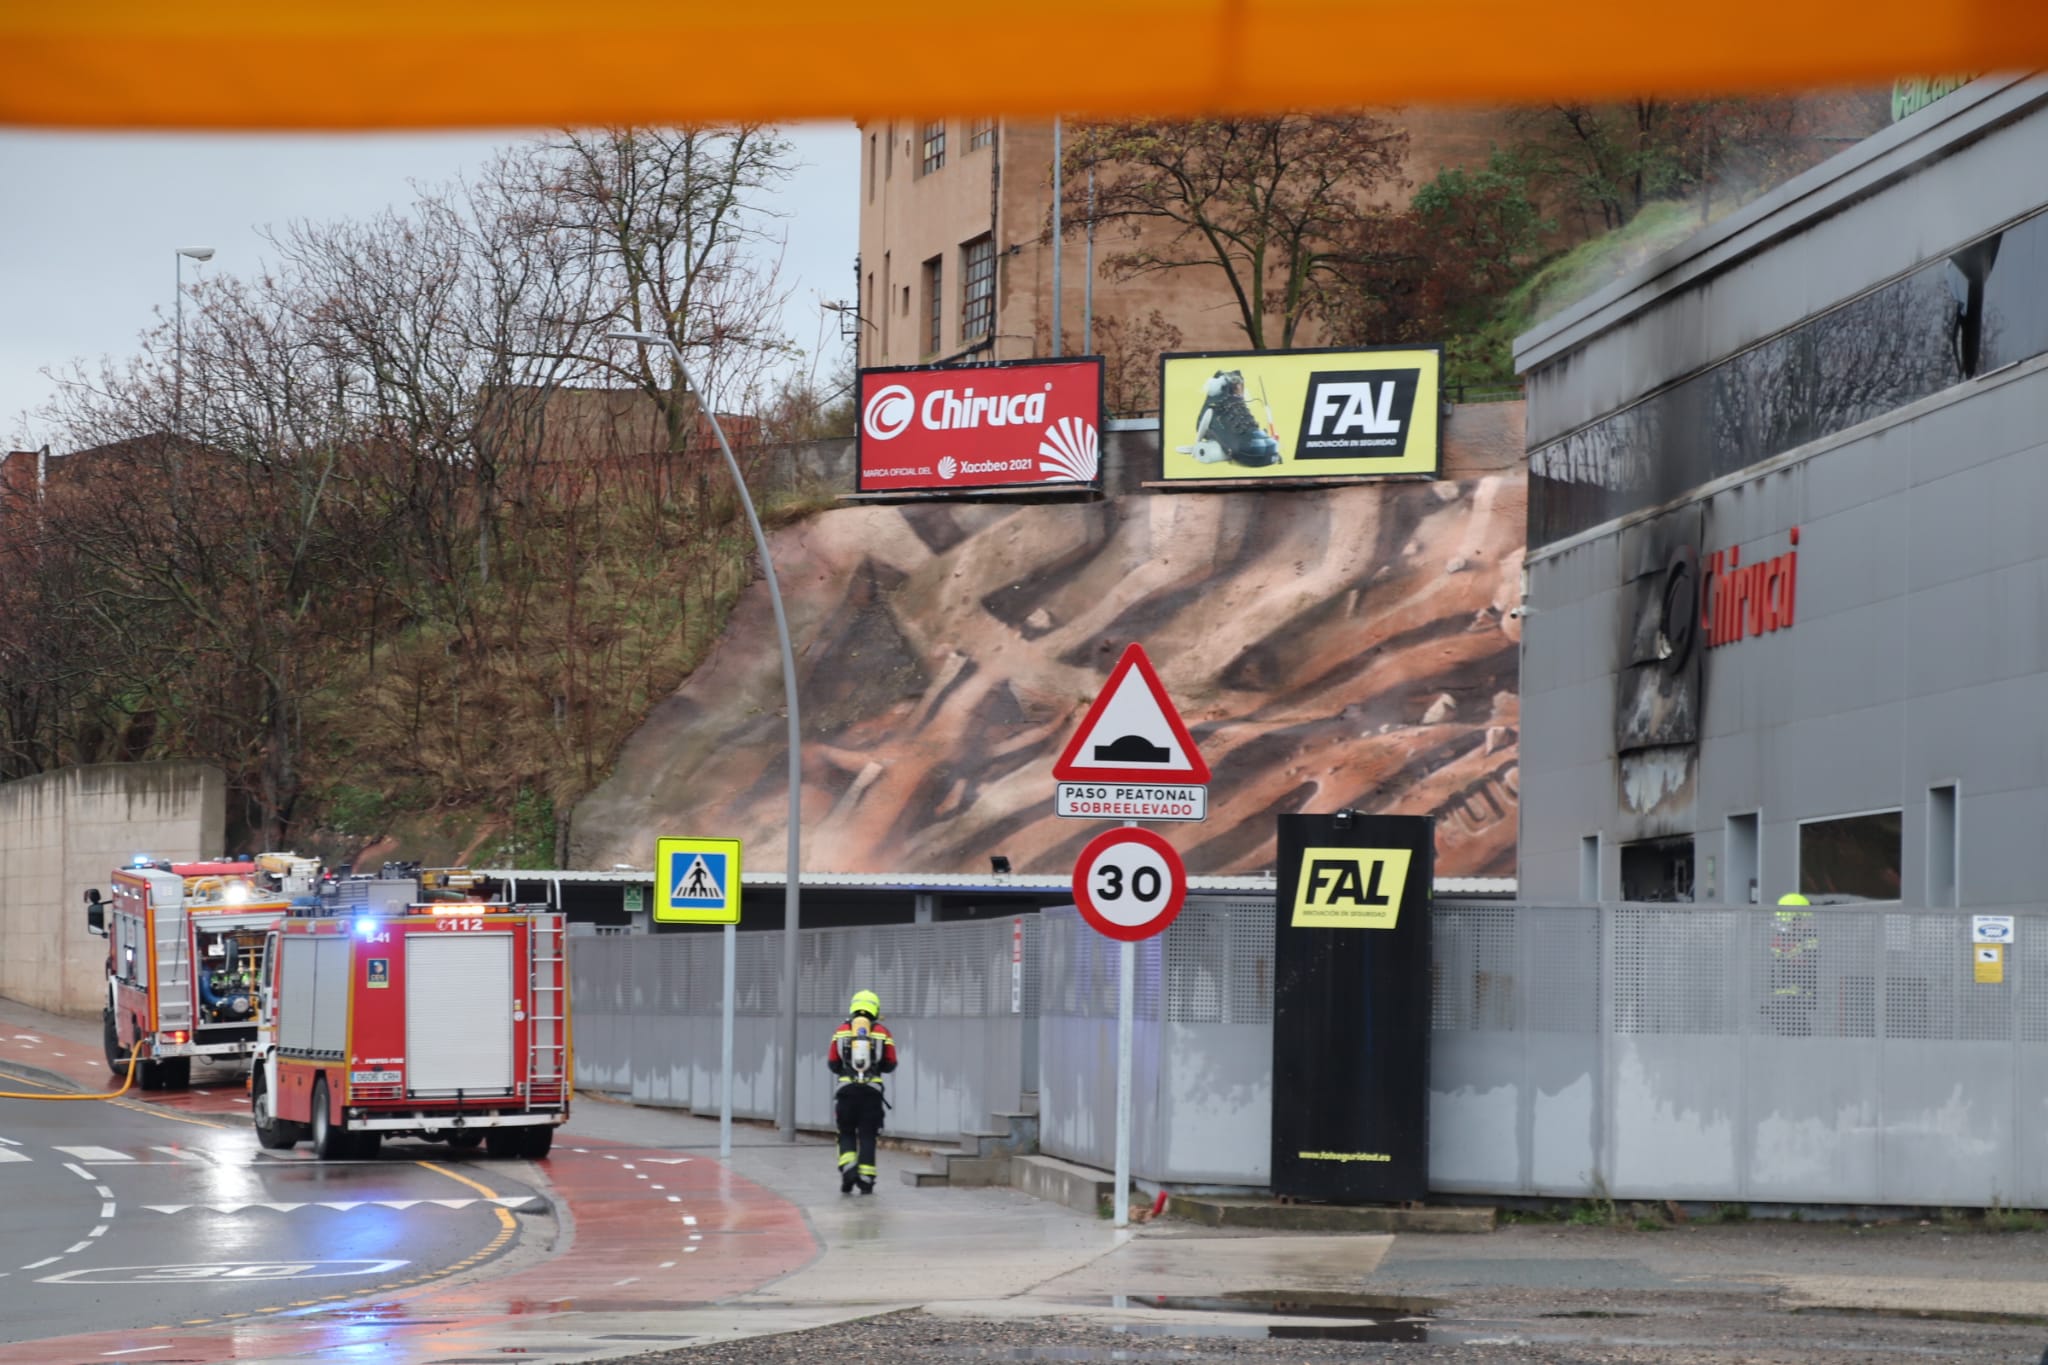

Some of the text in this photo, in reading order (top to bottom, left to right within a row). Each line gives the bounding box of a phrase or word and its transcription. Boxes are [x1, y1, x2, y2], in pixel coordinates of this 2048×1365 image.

[921, 387, 1046, 430] Chiruca
[1308, 381, 1401, 435] FAL
[863, 458, 1033, 478] MARCA OFICIAL DEL Xacobeo 2021
[1066, 787, 1196, 801] PASO PEATONAL
[1070, 802, 1192, 815] SOBREELEVADO
[1096, 864, 1161, 902] 30
[1305, 859, 1389, 906] FAL
[447, 919, 483, 931] 112
